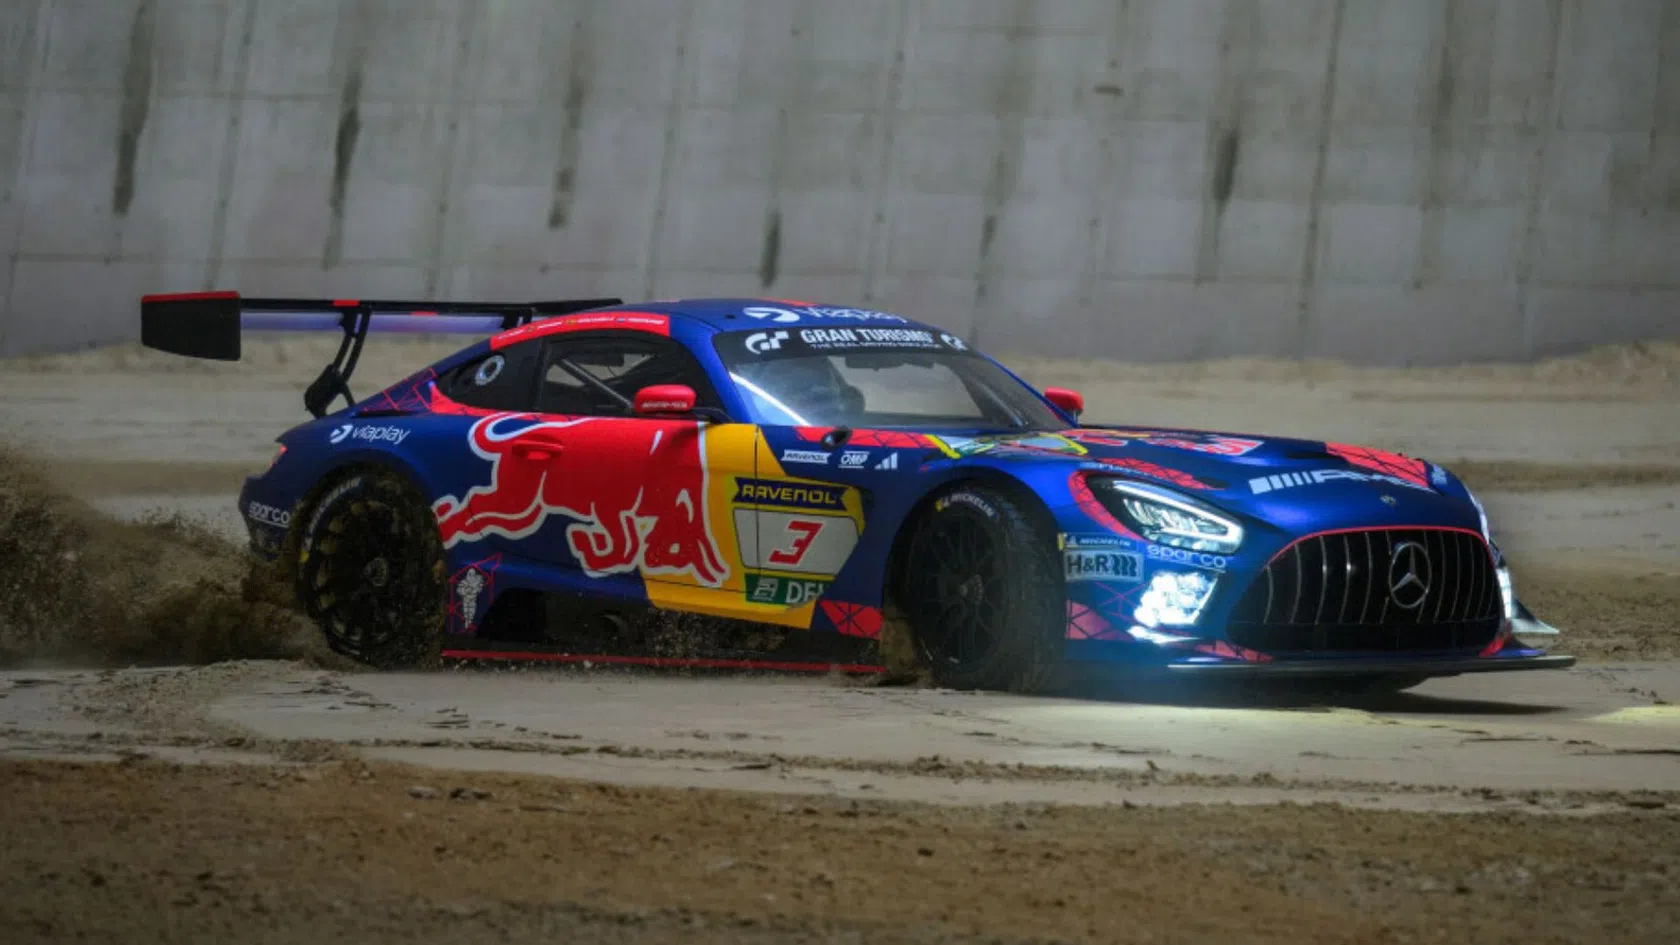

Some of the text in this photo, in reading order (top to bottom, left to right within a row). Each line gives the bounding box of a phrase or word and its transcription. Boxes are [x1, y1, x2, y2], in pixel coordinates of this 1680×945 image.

[801, 329, 933, 344] GRAN TURISMO
[352, 425, 411, 445] viaplay
[742, 484, 837, 504] RAVENOL
[768, 519, 824, 565] 3
[1067, 554, 1110, 574] H&R
[1147, 545, 1227, 568] sparco
